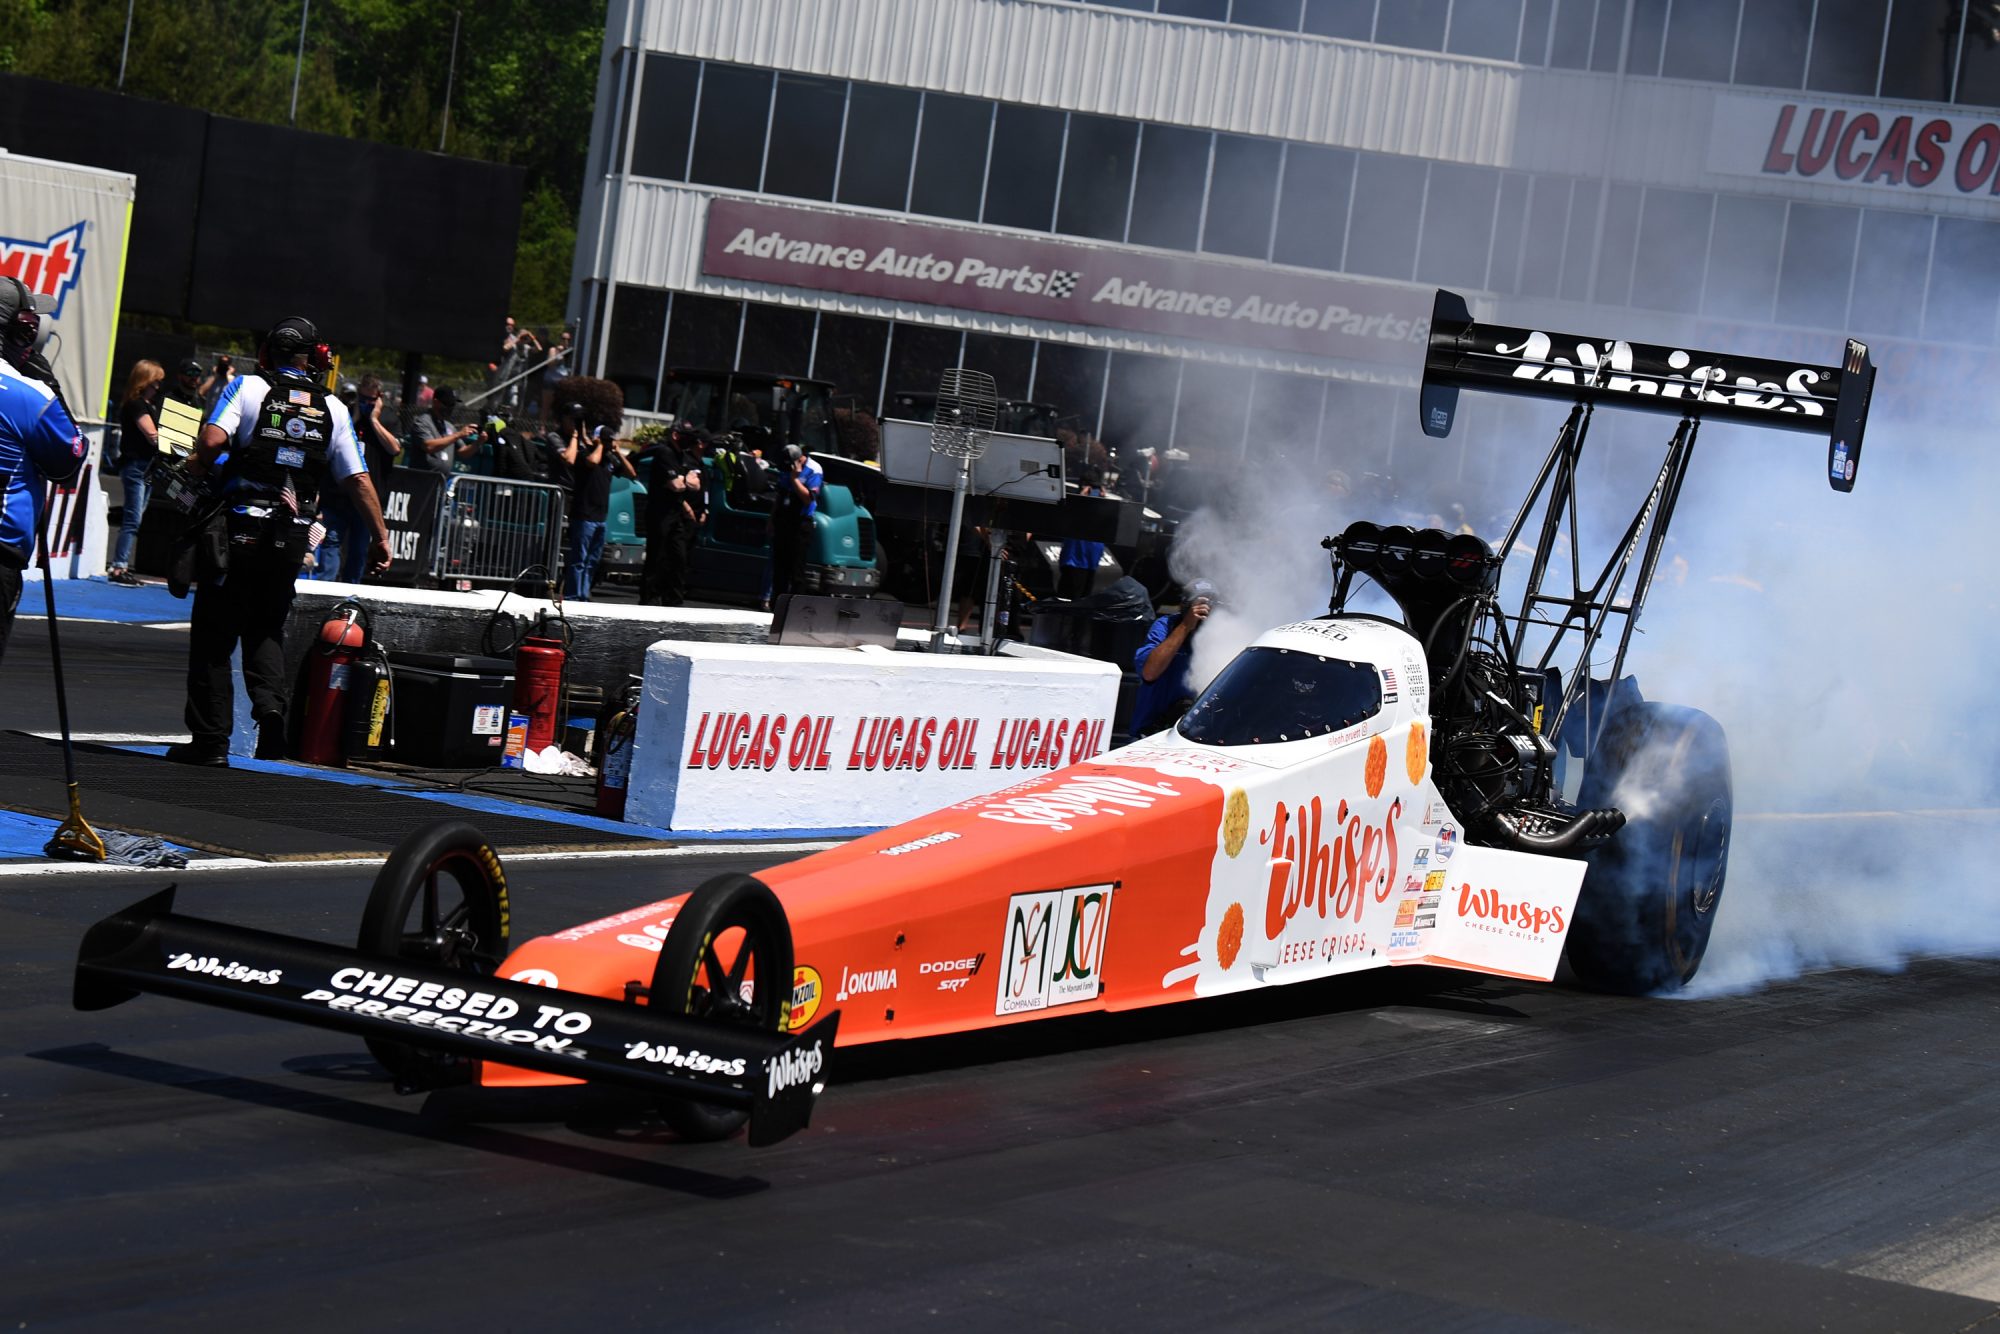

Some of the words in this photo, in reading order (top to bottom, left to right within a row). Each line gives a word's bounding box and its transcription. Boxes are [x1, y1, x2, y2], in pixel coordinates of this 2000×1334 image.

[1761, 104, 1952, 188] LUCAS
[1954, 122, 2000, 196] O
[724, 227, 866, 270] Advance
[865, 246, 954, 283] Auto
[954, 257, 1047, 296] Parts
[1091, 277, 1233, 319] Advance
[1231, 294, 1321, 329] Auto
[1318, 305, 1411, 341] Parts
[384, 490, 411, 522] ACK
[385, 529, 420, 560] ALIST
[686, 712, 788, 772] LUCAS
[787, 713, 835, 772] OIL
[846, 716, 937, 772] LUCAS
[938, 717, 979, 771] OIL
[989, 718, 1069, 770] LUCAS
[1069, 718, 1106, 766] OIL
[978, 775, 1181, 832] Whisps
[1260, 795, 1402, 941] Whisps
[1451, 882, 1565, 934] Whisps
[1465, 921, 1504, 935] CHEESE
[1509, 930, 1545, 943] CRISPS
[168, 953, 283, 985] Whisps
[919, 958, 977, 975] DODGE
[1281, 940, 1316, 964] EESE
[1322, 933, 1366, 957] CRISPS
[330, 967, 518, 1021] CHEESED
[529, 1004, 592, 1035] TO
[847, 968, 897, 995] OKUMA
[937, 978, 970, 993] SRT
[301, 988, 574, 1051] PERFECTION
[624, 1041, 746, 1077] Whisps
[766, 1039, 823, 1100] Whisps
